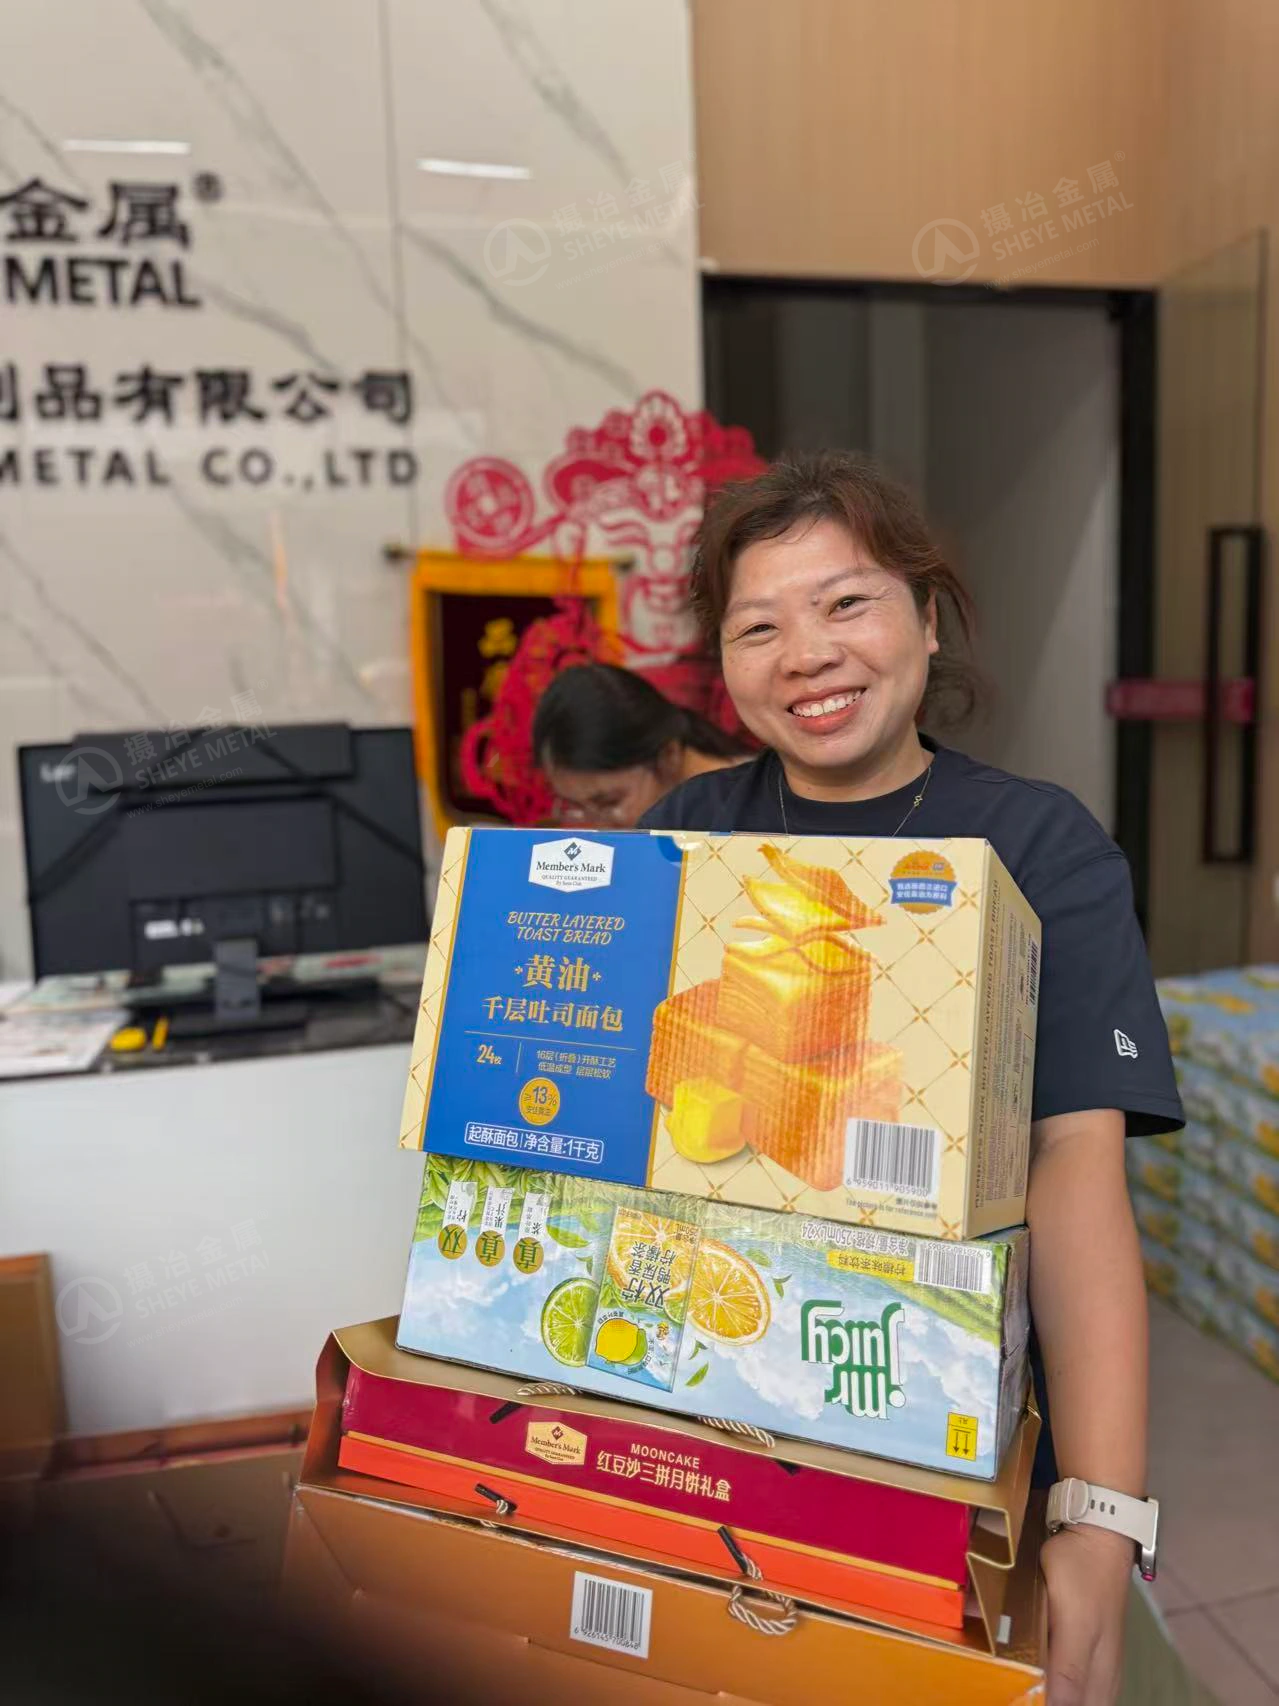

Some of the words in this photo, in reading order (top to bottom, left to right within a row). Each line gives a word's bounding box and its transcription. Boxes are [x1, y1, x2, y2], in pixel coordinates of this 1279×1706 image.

[0, 178, 190, 249] 金属
[4, 256, 202, 306] METAL
[202, 450, 418, 491] CO.,LTD
[536, 861, 579, 872] Member's
[580, 862, 606, 873] Mark
[507, 911, 561, 927] BUTTER
[562, 914, 625, 931] LAYERED
[517, 926, 561, 941] TOAST
[562, 929, 612, 945] BREAD
[522, 953, 592, 993] 黄油
[481, 996, 624, 1032] 千层吐司面包
[467, 1125, 519, 1148] 起酥面包
[631, 1241, 677, 1266] 柠檬茶
[629, 1259, 671, 1285] 鸭屎香
[621, 1278, 670, 1309] 双柠
[803, 1301, 906, 1408] juicy
[830, 1367, 890, 1420] mr
[530, 1436, 562, 1450] Member's
[562, 1443, 581, 1455] Mark
[630, 1443, 700, 1469] MOONCAKE
[596, 1450, 732, 1502] 红豆沙三拼月饼礼盒
